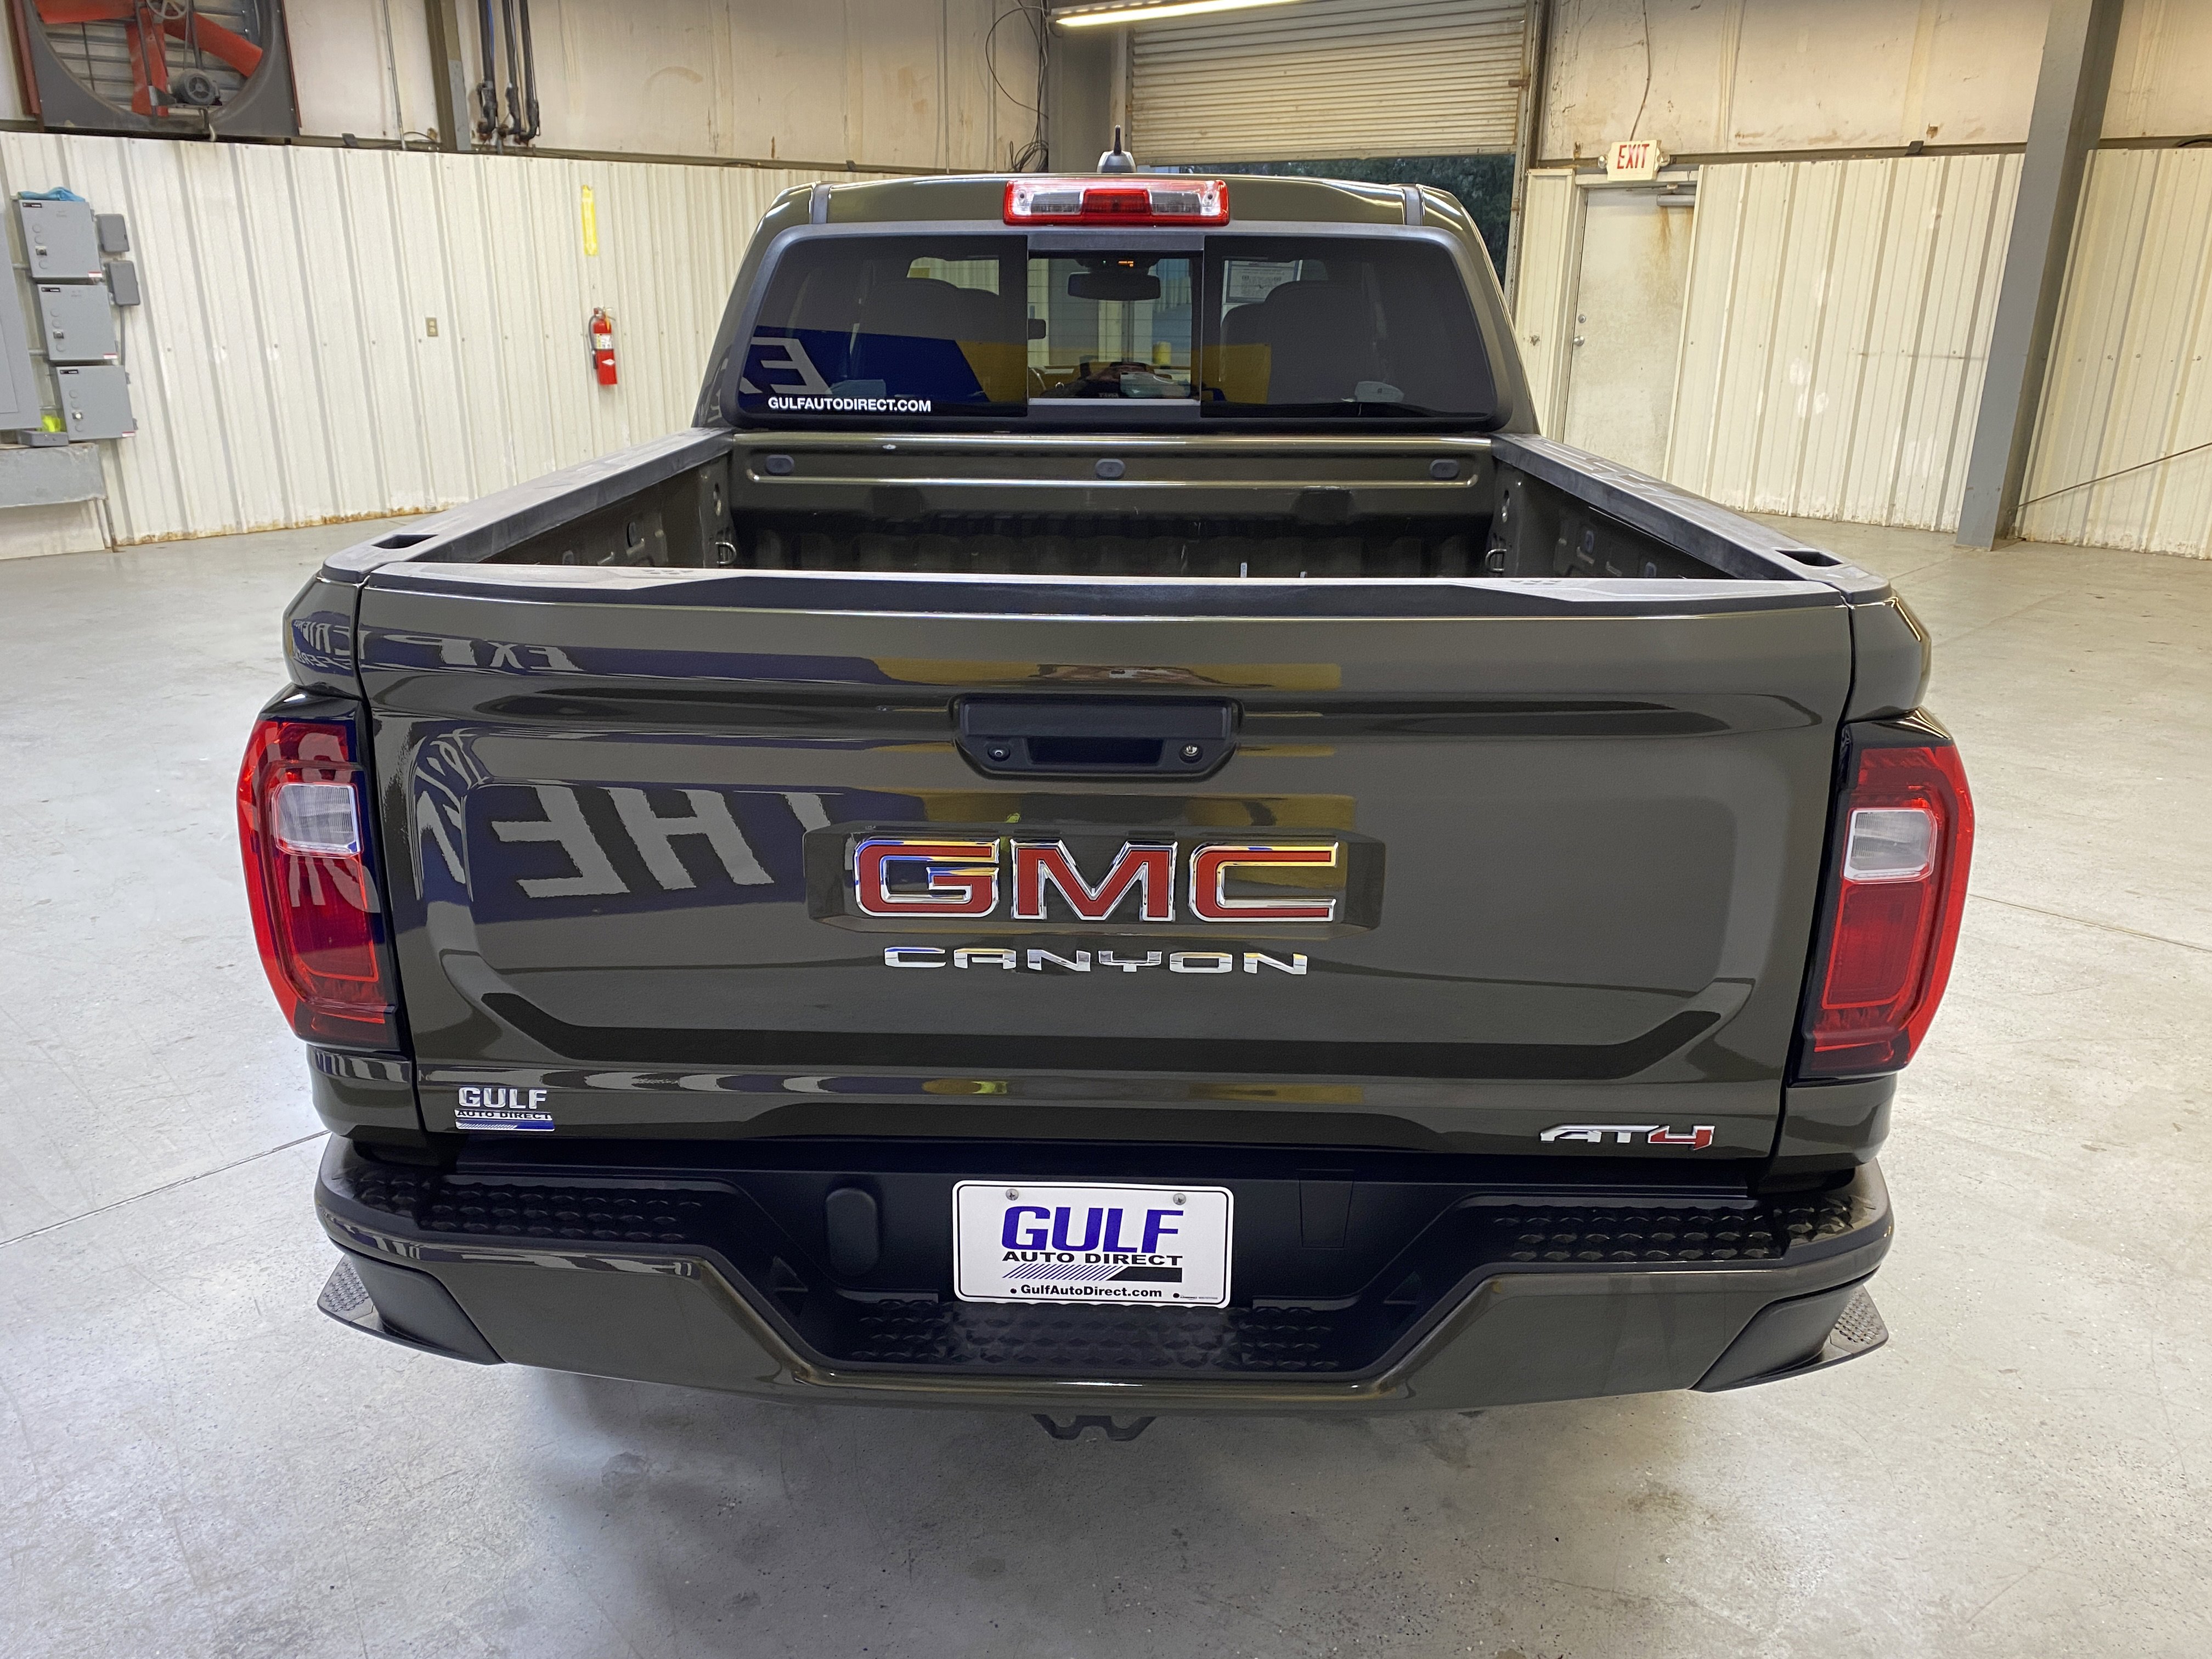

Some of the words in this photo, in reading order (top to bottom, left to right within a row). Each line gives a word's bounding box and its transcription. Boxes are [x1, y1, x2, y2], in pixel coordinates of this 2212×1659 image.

[1617, 143, 1650, 170] EXIT
[768, 396, 932, 412] GULFAUTODIRECT.COM
[854, 838, 1339, 922] GMC
[884, 945, 1308, 975] CANYON
[458, 1086, 548, 1110] GULF
[1539, 1124, 1716, 1151] AT4
[1002, 1206, 1184, 1254] GULF
[1002, 1251, 1075, 1264] AUTO
[1085, 1254, 1183, 1266] DIRECT
[1020, 1284, 1162, 1298] GulfAutoDirect.com
